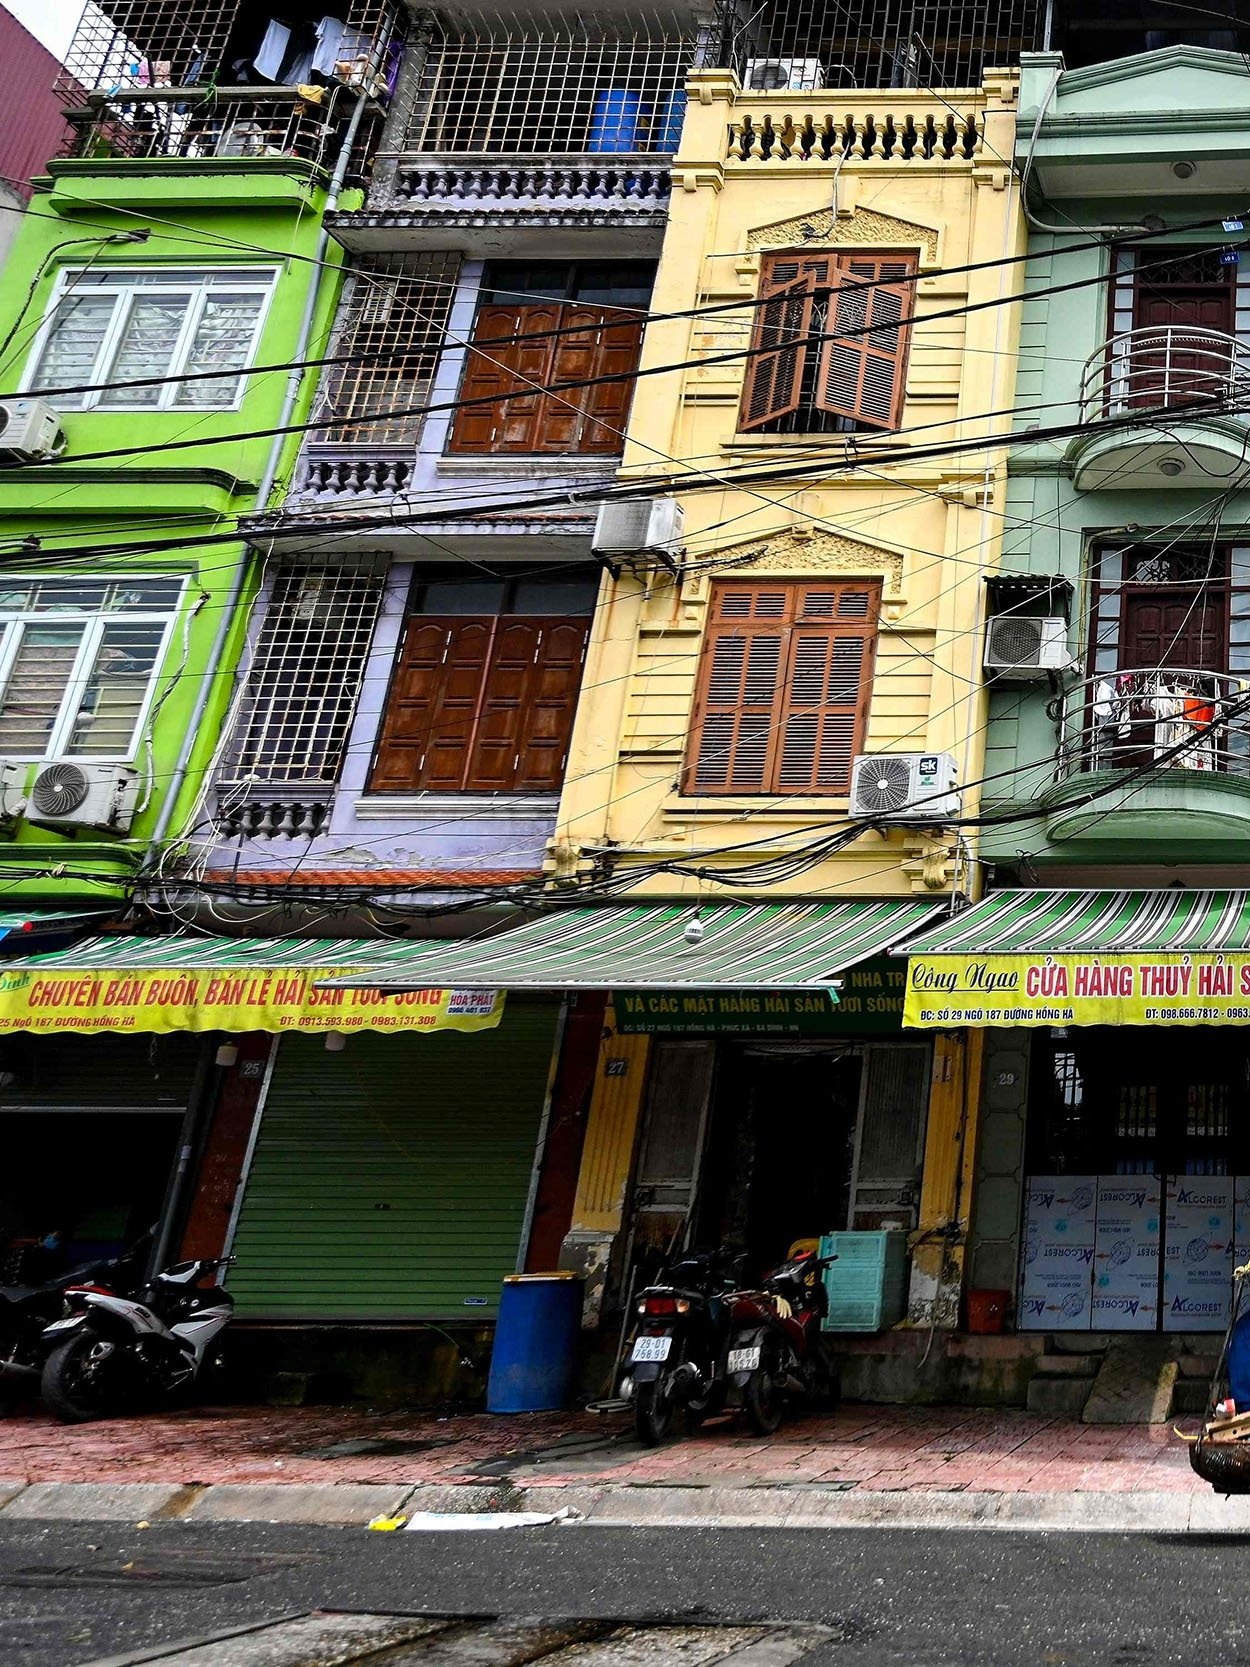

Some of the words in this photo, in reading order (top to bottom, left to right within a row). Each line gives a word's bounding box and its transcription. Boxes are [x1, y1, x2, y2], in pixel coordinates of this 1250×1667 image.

[920, 759, 936, 771] sk
[911, 963, 958, 994] Công
[965, 962, 1020, 994] Ngao
[1026, 955, 1069, 997] CỬA
[1074, 960, 1133, 998] HÀNG
[1199, 954, 1233, 996] HẢI
[28, 974, 104, 1008] CHUYÊN
[103, 974, 148, 1006] BÁN
[203, 973, 250, 1006] BÁN
[246, 969, 273, 1006] LẺ
[272, 969, 307, 1006] HẢI
[625, 995, 646, 1013] VÀ
[649, 995, 680, 1013] CÁC
[683, 996, 715, 1015] MẶT
[719, 995, 761, 1013] HÀNG
[795, 992, 826, 1013] SẢN
[298, 1016, 363, 1027] 0913.593.980
[370, 1015, 437, 1026] 0983.131.308
[921, 1009, 935, 1021] ĐC:
[951, 1009, 962, 1020] 29
[986, 1009, 1001, 1020] 187
[1004, 1007, 1033, 1020] ĐƯỜNG
[1062, 1008, 1073, 1019] HÀ
[1146, 1008, 1159, 1019] ĐT:
[1161, 1008, 1219, 1019] 098.666.7812
[35, 1016, 54, 1027] 187
[244, 1062, 260, 1076] 25
[608, 1061, 625, 1074] 27
[999, 1072, 1014, 1086] 29
[1100, 1193, 1147, 1209] ALCOREST
[1177, 1188, 1227, 1204] ALCOREST
[1043, 1249, 1095, 1265] ALCOREST
[1171, 1295, 1223, 1312] ALCOREST
